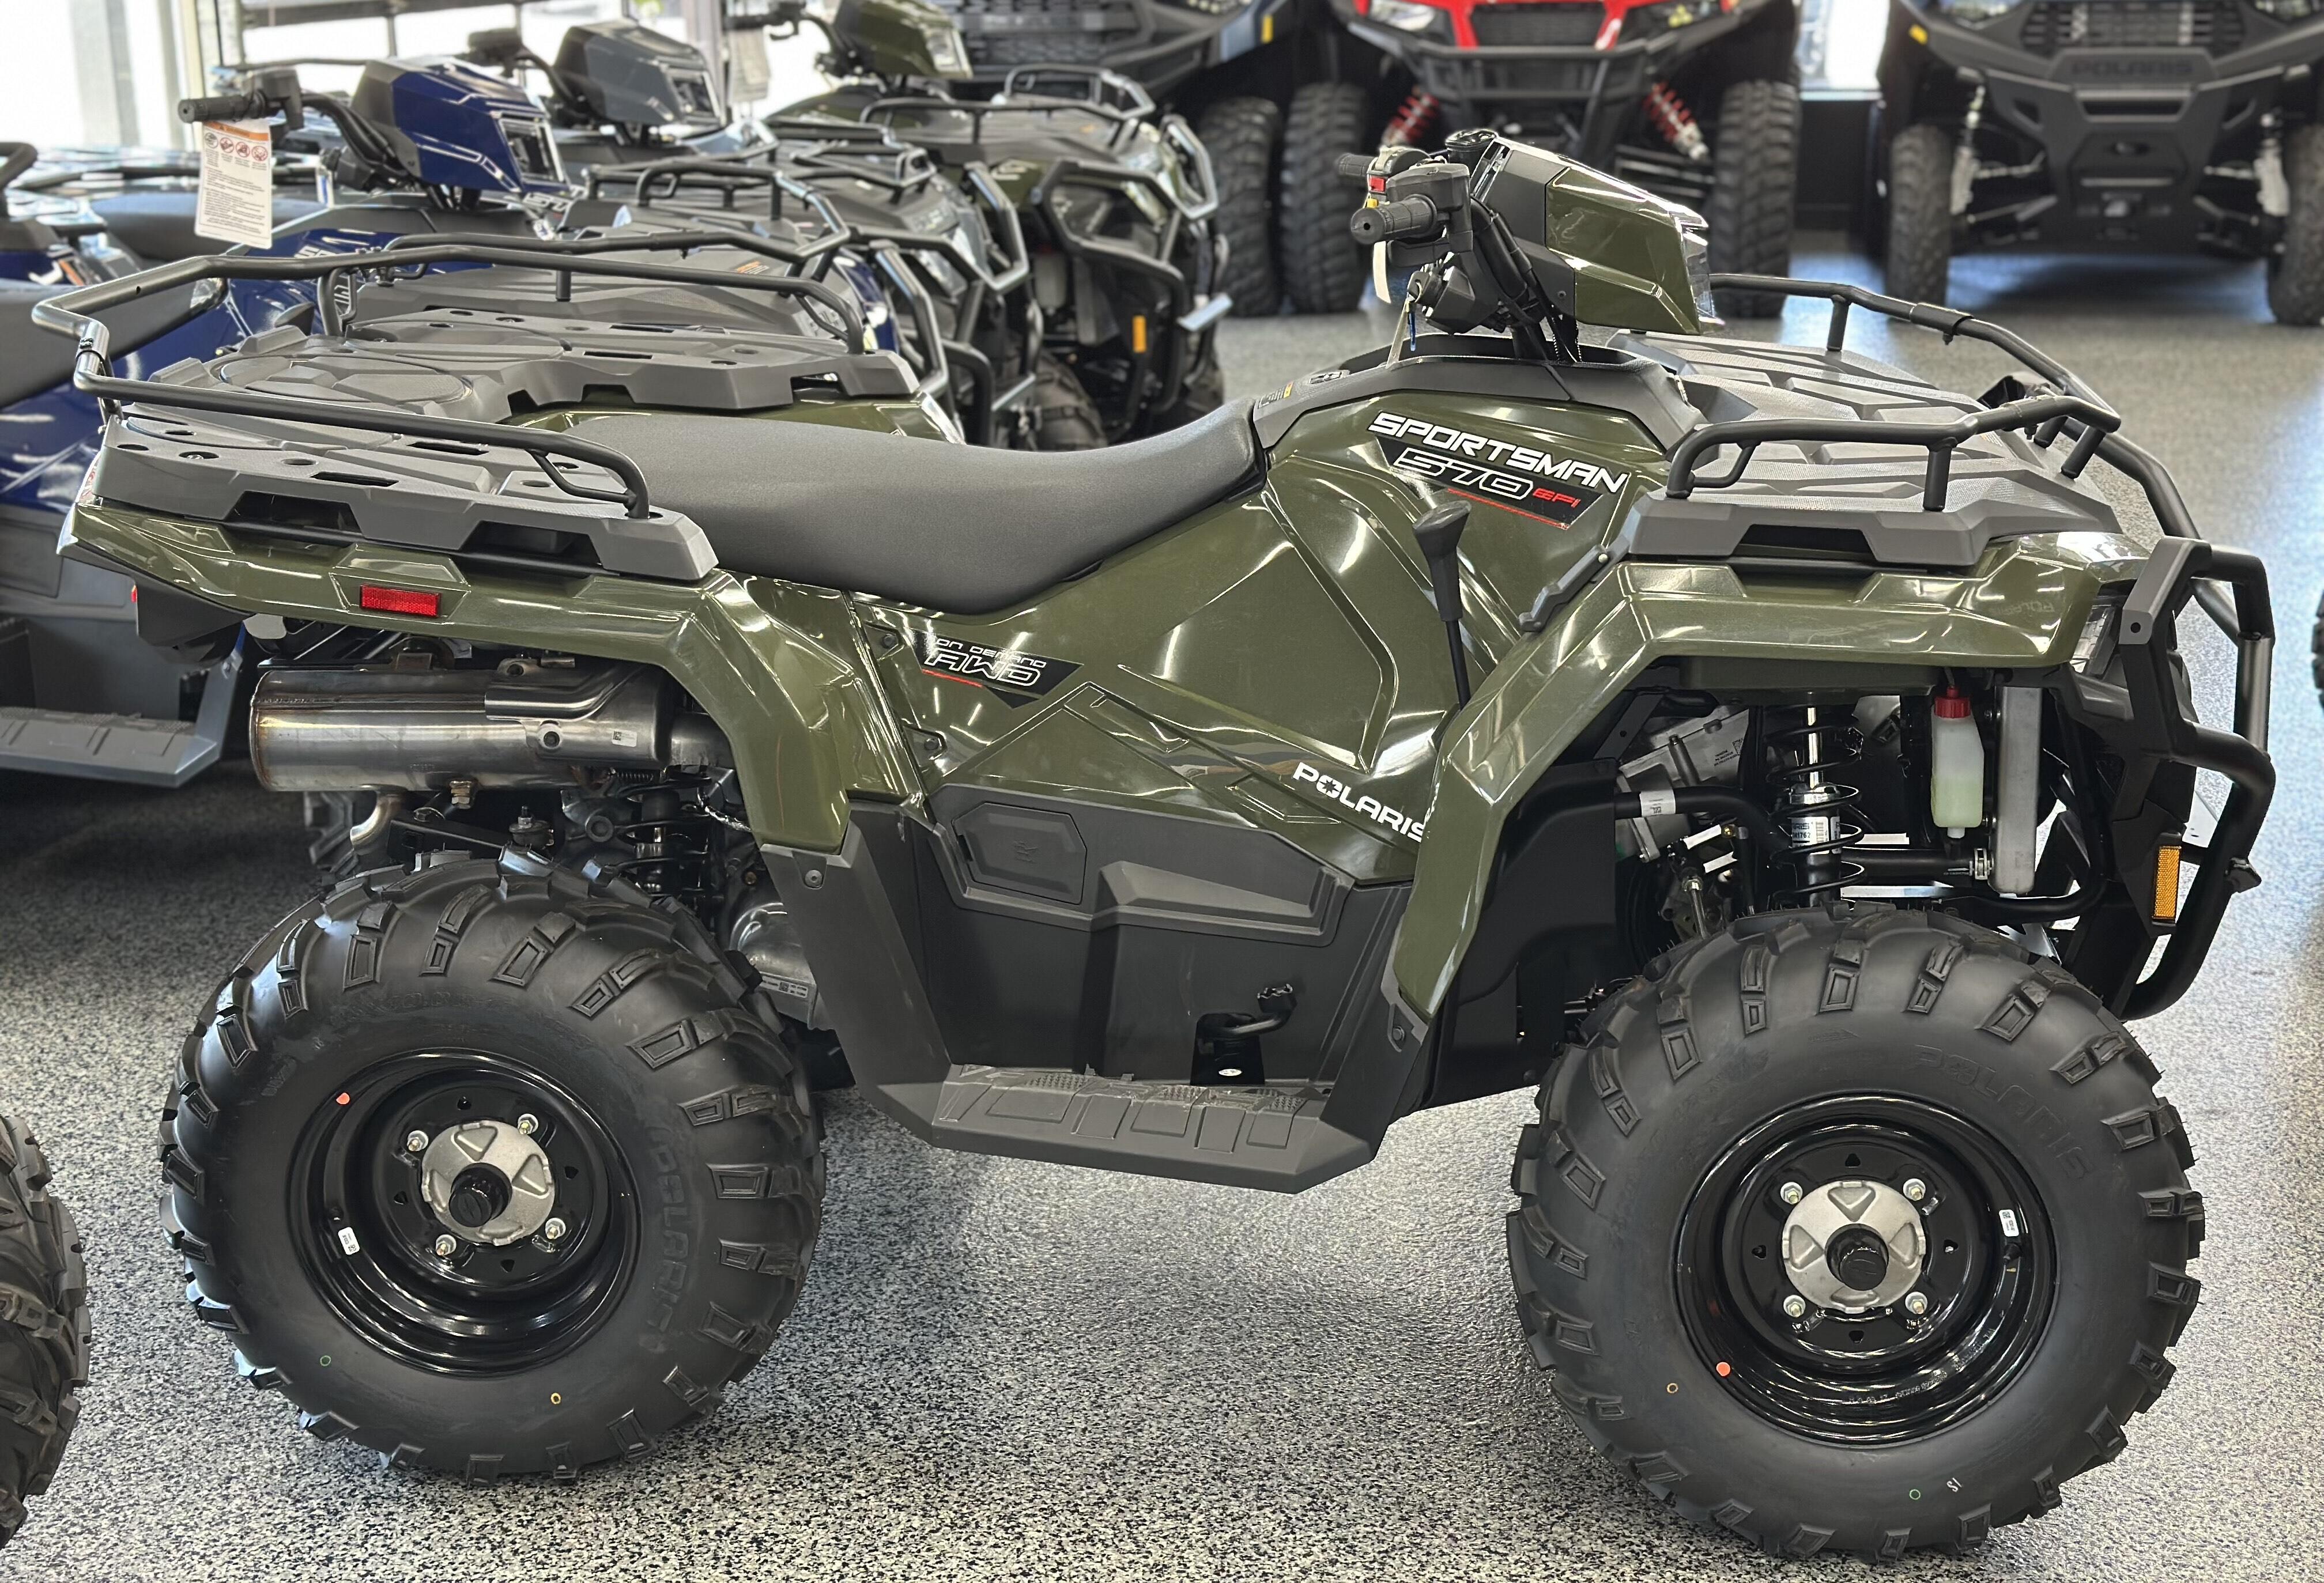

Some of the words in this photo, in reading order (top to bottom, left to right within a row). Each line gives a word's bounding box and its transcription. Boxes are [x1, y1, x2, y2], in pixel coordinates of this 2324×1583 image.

[1368, 411, 1633, 494] SPORTSMAN
[1393, 447, 1533, 501] 570
[1532, 487, 1581, 509] EFI
[923, 647, 1042, 686] AWD
[1292, 761, 1426, 843] POLARIS
